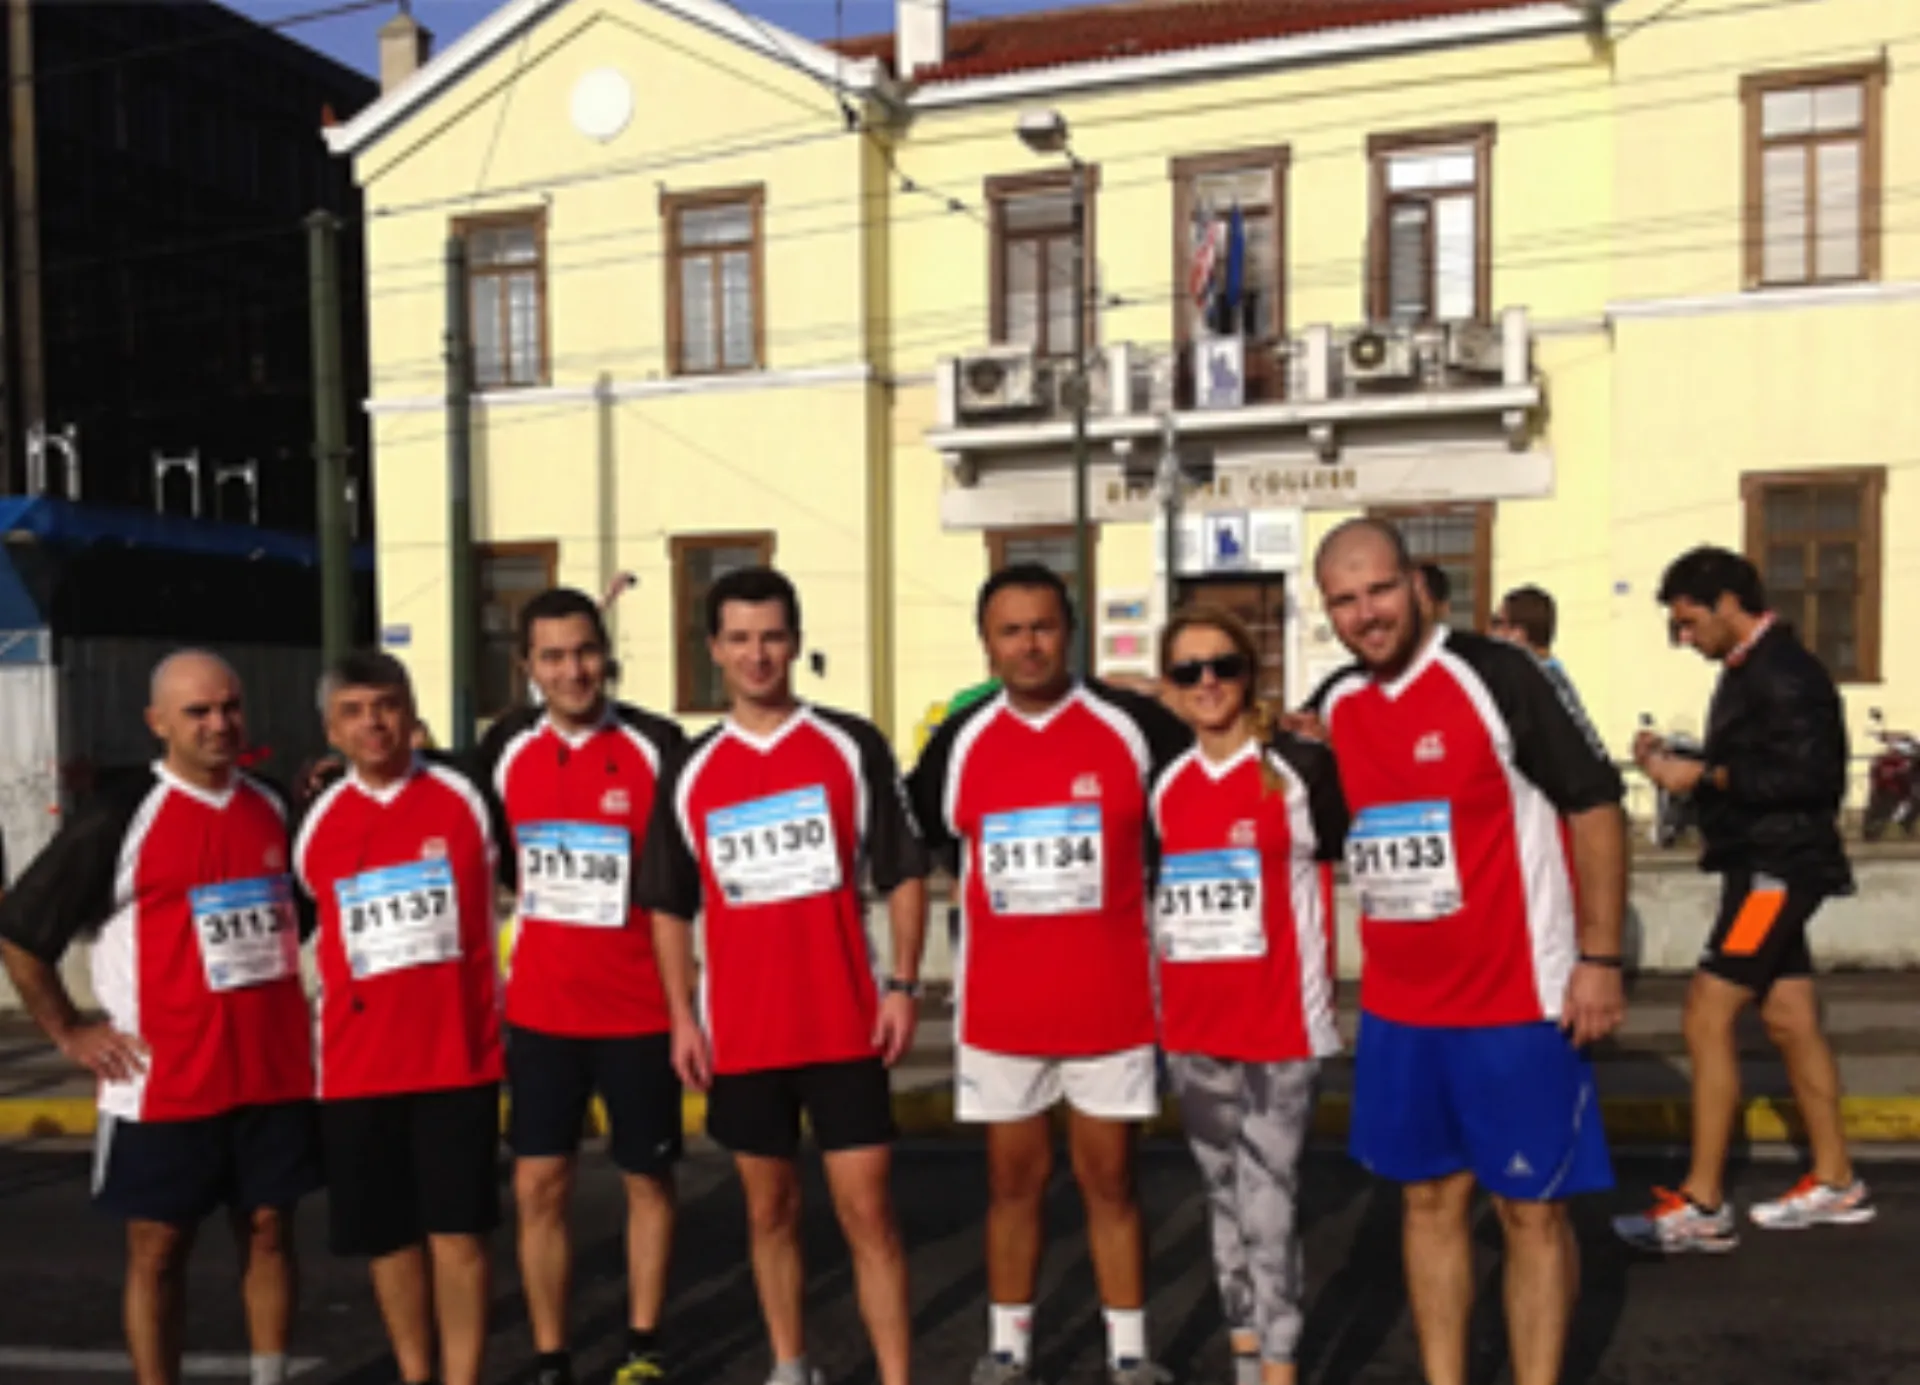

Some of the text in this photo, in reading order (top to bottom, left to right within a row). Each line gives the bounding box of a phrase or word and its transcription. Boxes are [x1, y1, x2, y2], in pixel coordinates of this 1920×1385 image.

[717, 818, 825, 863] 31130
[988, 836, 1096, 874] 31134
[1353, 834, 1446, 874] 31133
[1159, 882, 1255, 915] 31127
[203, 906, 290, 945] 3113
